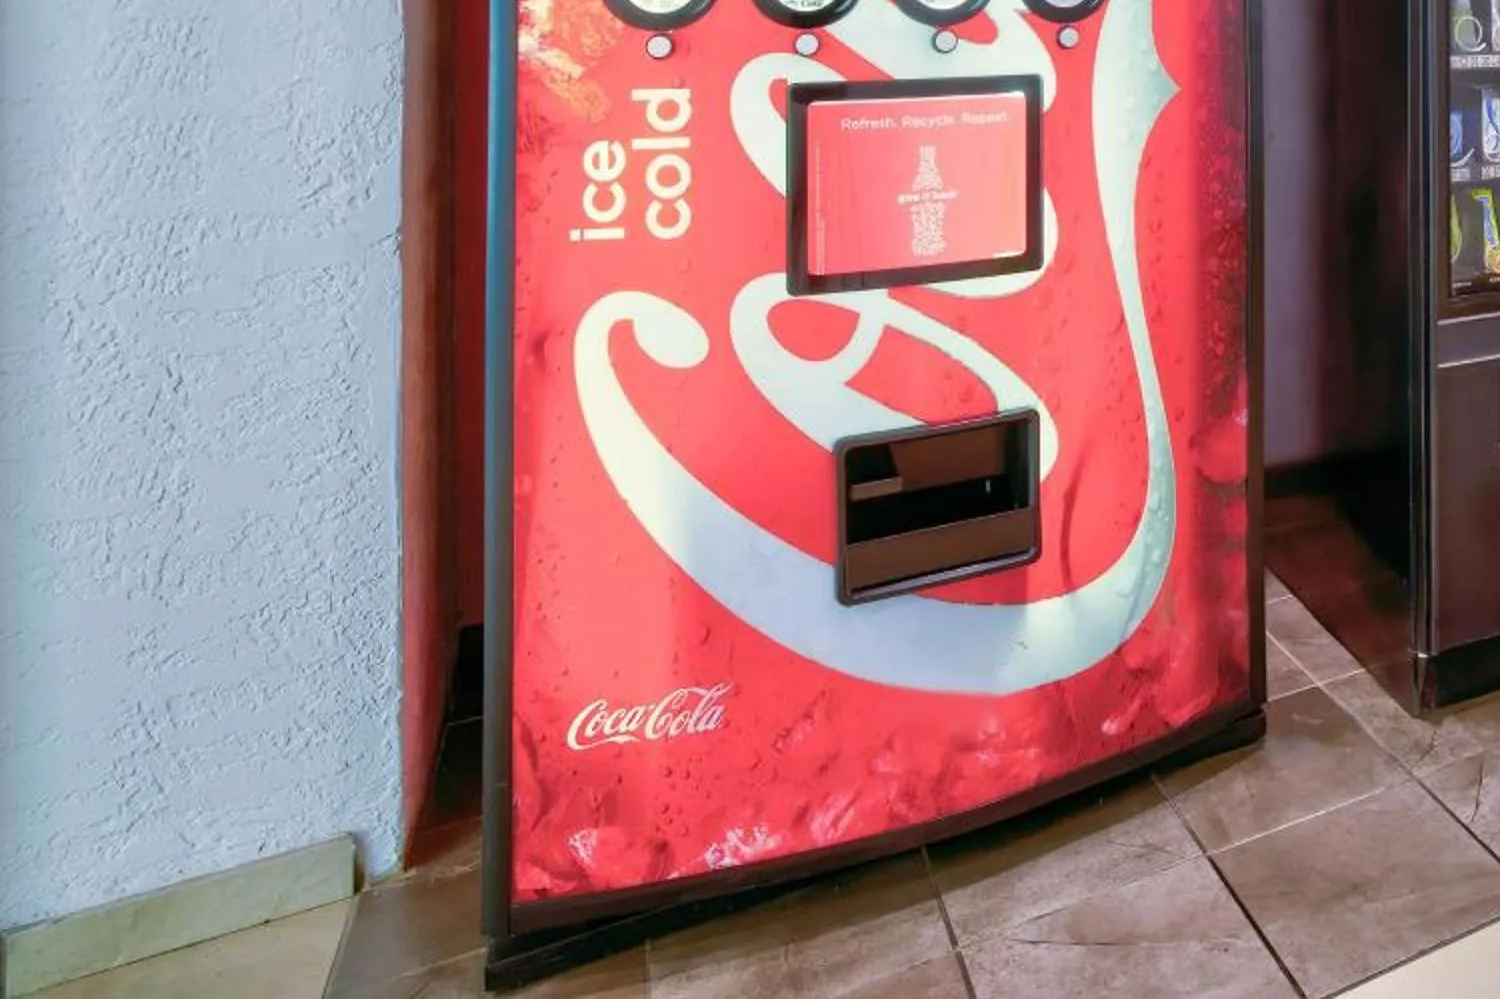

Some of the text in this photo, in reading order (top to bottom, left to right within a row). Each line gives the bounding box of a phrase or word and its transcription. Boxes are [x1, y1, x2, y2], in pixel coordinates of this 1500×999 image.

[569, 139, 627, 242] ice
[631, 87, 692, 240] cold
[566, 681, 734, 751] Coca-Cola
